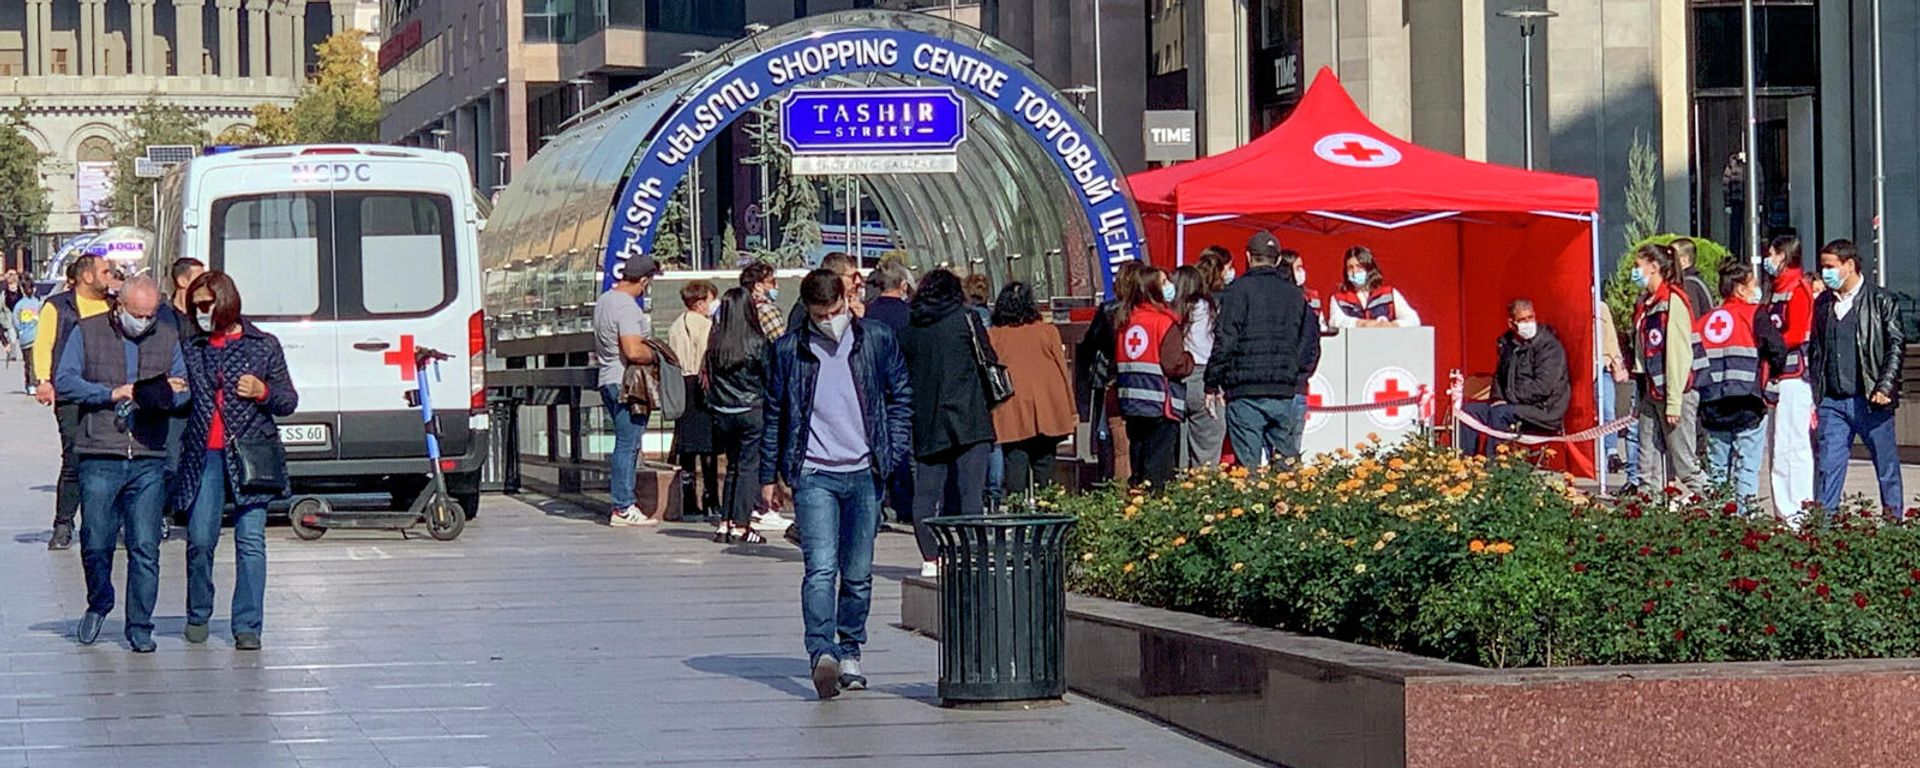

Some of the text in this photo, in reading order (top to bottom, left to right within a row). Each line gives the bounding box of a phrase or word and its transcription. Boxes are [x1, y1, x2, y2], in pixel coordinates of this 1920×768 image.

[767, 38, 1009, 99] SHOPPING CENTRE
[1274, 54, 1297, 88] TIME
[812, 102, 934, 123] TASHIR
[835, 125, 913, 138] STREET
[1150, 127, 1192, 143] TIME
[292, 163, 370, 183] NCDC
[611, 77, 760, 285] ԵՎՏՐԻ ԿԵՆՏՐՈՆ
[1013, 86, 1136, 281] ТОРГОВЫЙ ЦЕН
[286, 427, 303, 440] SS
[307, 427, 322, 440] 60
